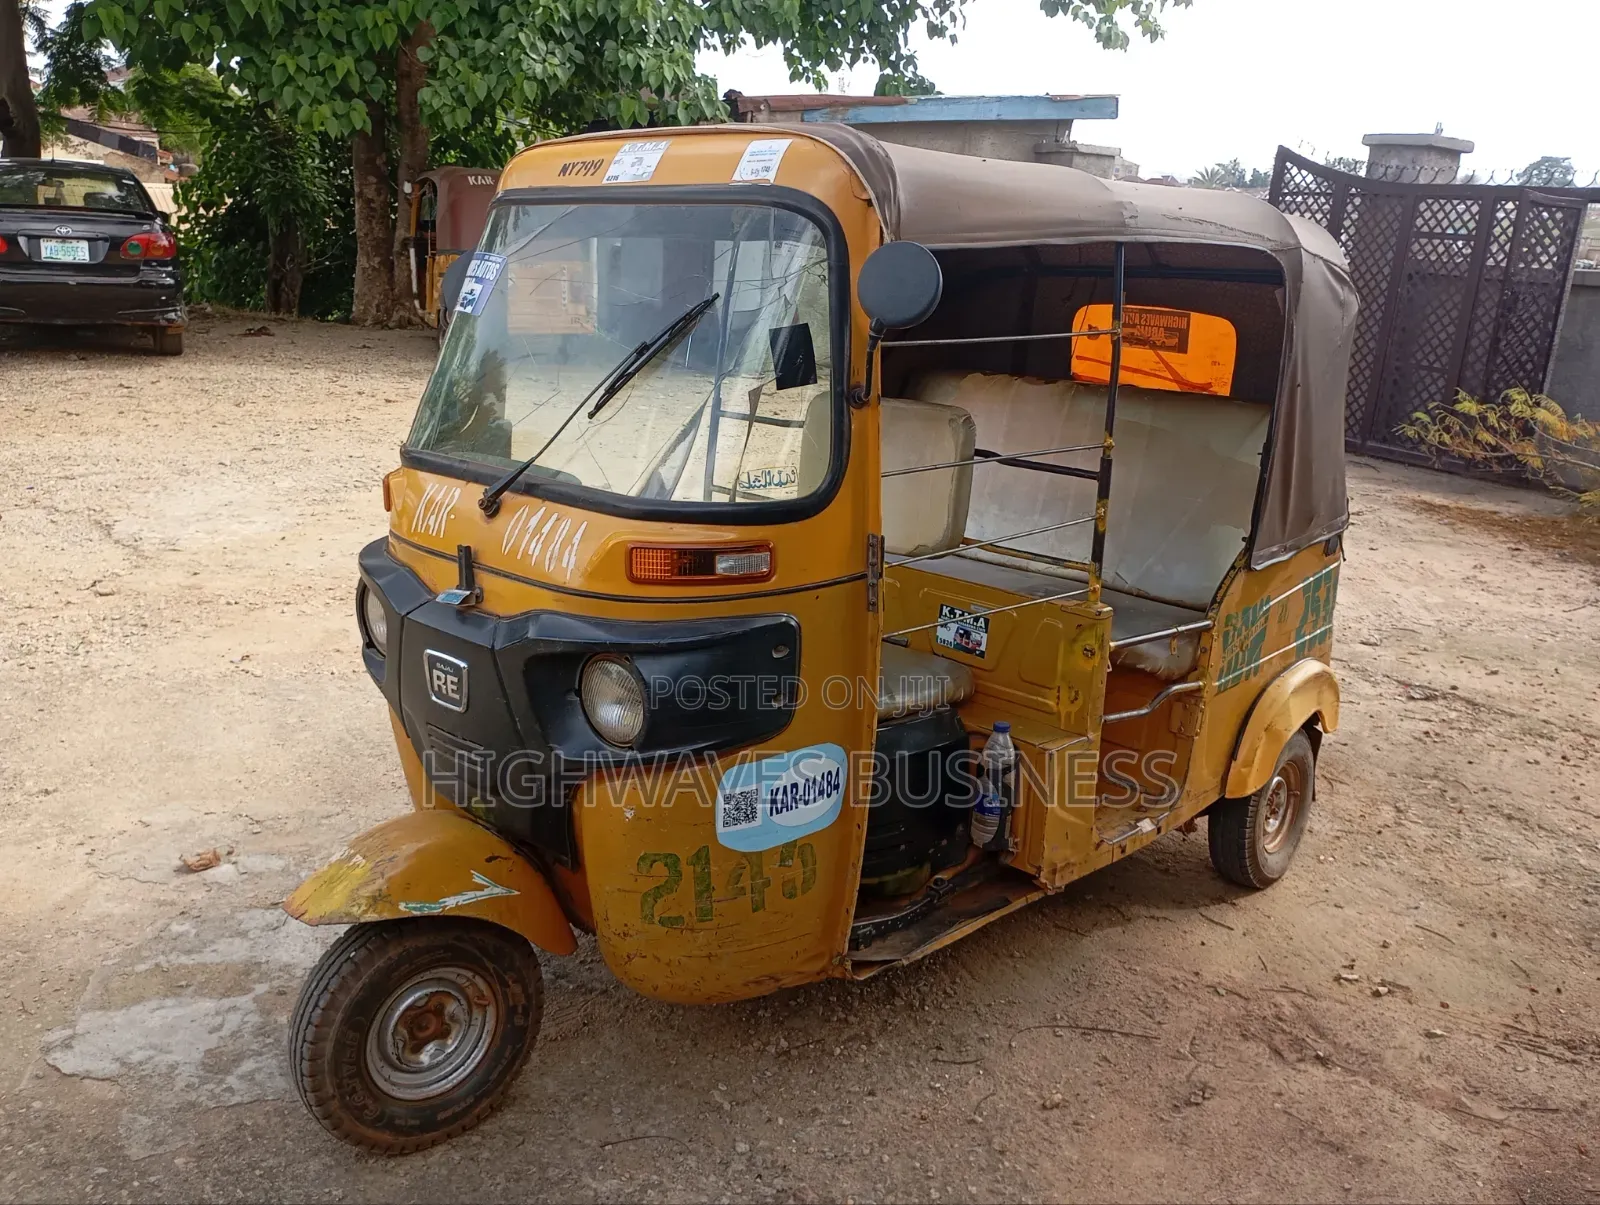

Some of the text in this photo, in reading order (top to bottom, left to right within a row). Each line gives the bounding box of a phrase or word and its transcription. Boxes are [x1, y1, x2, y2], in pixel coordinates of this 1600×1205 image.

[558, 158, 605, 177] NY799
[942, 605, 986, 629] K.TM.A
[432, 668, 460, 700] RE
[769, 766, 841, 817] KAR-01484
